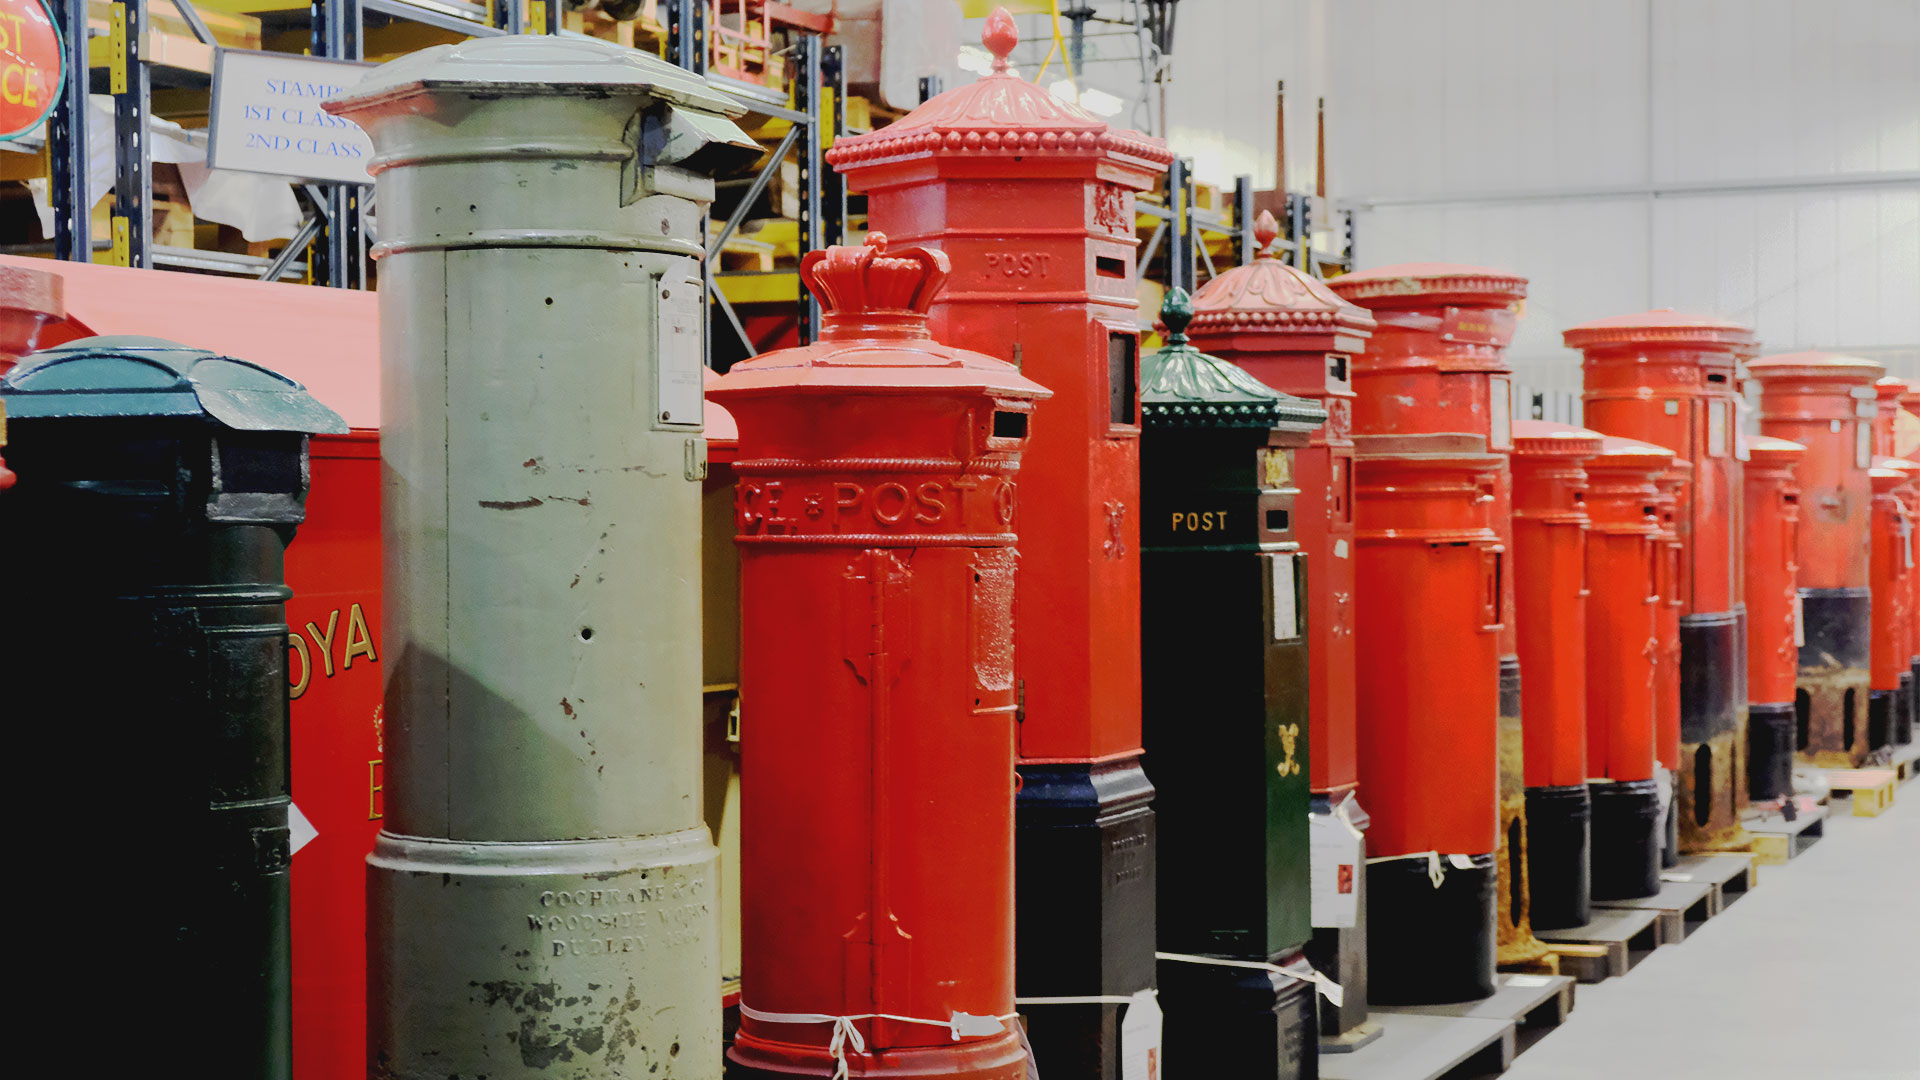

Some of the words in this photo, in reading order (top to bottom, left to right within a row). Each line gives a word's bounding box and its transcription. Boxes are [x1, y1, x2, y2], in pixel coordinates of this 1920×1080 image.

[266, 79, 344, 99] STAMP
[282, 109, 347, 129] CLASS
[246, 132, 290, 151] 2ND
[297, 138, 362, 158] CLASS
[985, 252, 1050, 279] POST
[832, 481, 978, 531] POST
[1172, 511, 1228, 531] POST
[540, 884, 665, 909] COCHRANE
